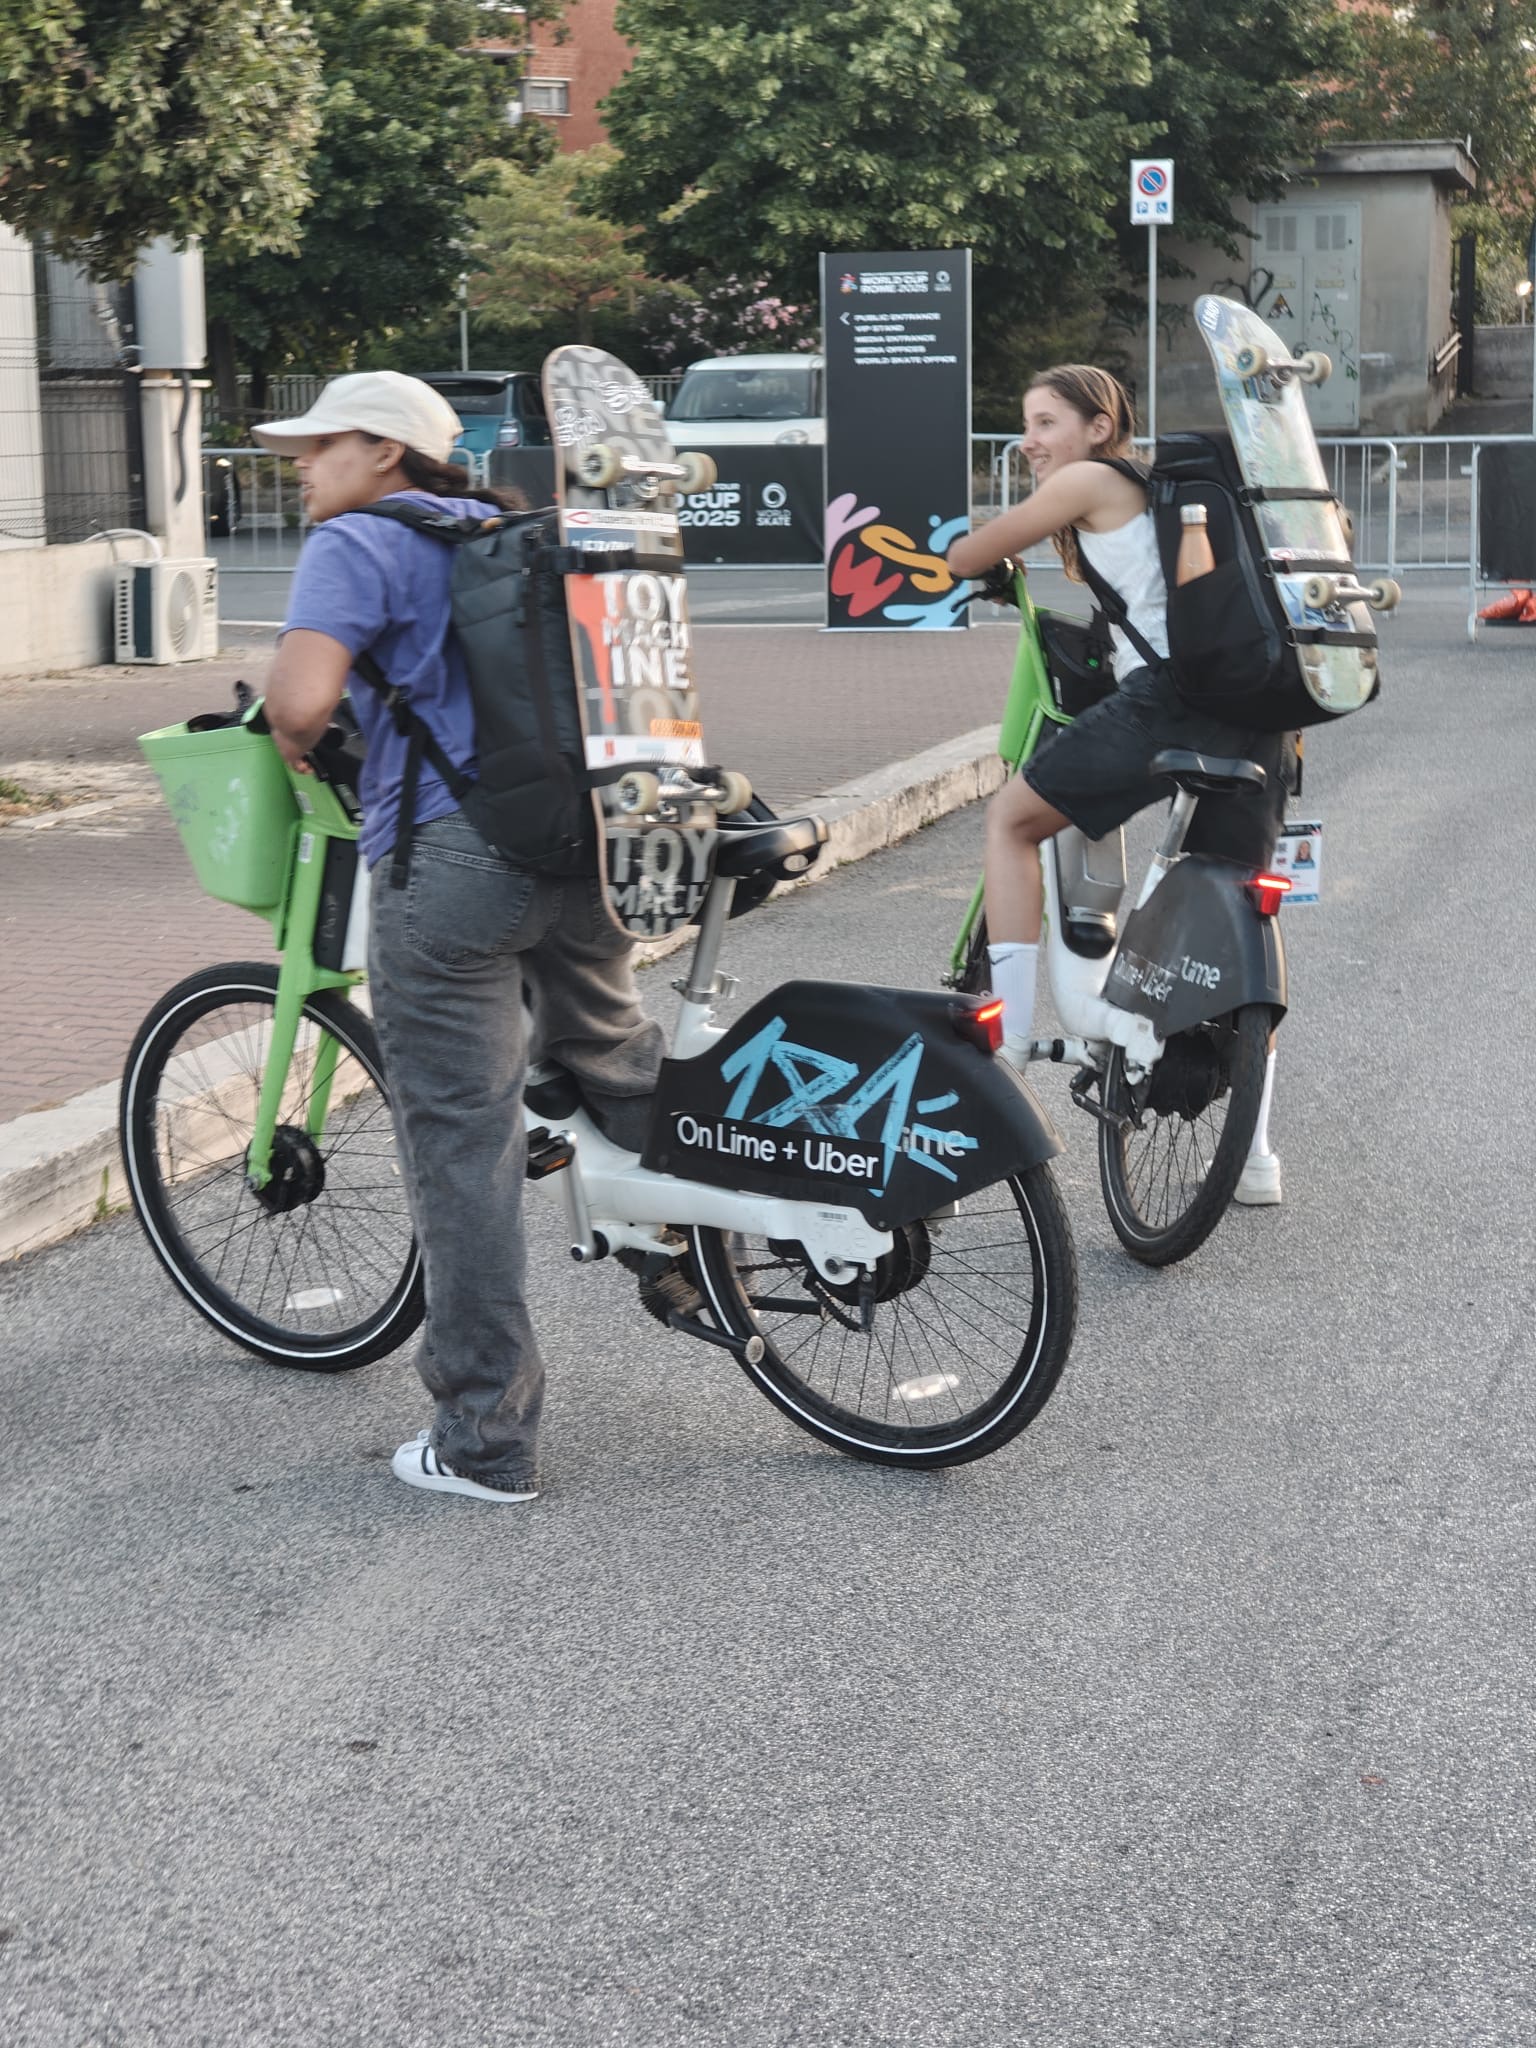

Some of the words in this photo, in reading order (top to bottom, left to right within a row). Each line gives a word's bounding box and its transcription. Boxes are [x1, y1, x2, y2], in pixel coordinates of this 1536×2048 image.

[902, 275, 928, 284] CUP
[854, 313, 889, 321] PUBLIC
[890, 312, 941, 321] ENTRANCE
[854, 335, 885, 343] MEDIA
[885, 334, 936, 342] ENTRANCE
[854, 346, 885, 354] MEDIA
[854, 357, 890, 365] WORLD
[890, 356, 922, 364] SKATE
[688, 492, 741, 509] CUP
[679, 510, 741, 527] 2025
[756, 509, 791, 517] WORLD
[756, 517, 791, 526] SKATE
[593, 574, 687, 621] TOY
[611, 646, 690, 688] INE
[606, 827, 718, 883] TOY
[677, 1116, 712, 1149] On
[717, 1123, 776, 1162] Lime
[782, 1141, 798, 1160] +
[804, 1139, 879, 1178] Uber
[894, 1125, 968, 1157] ime
